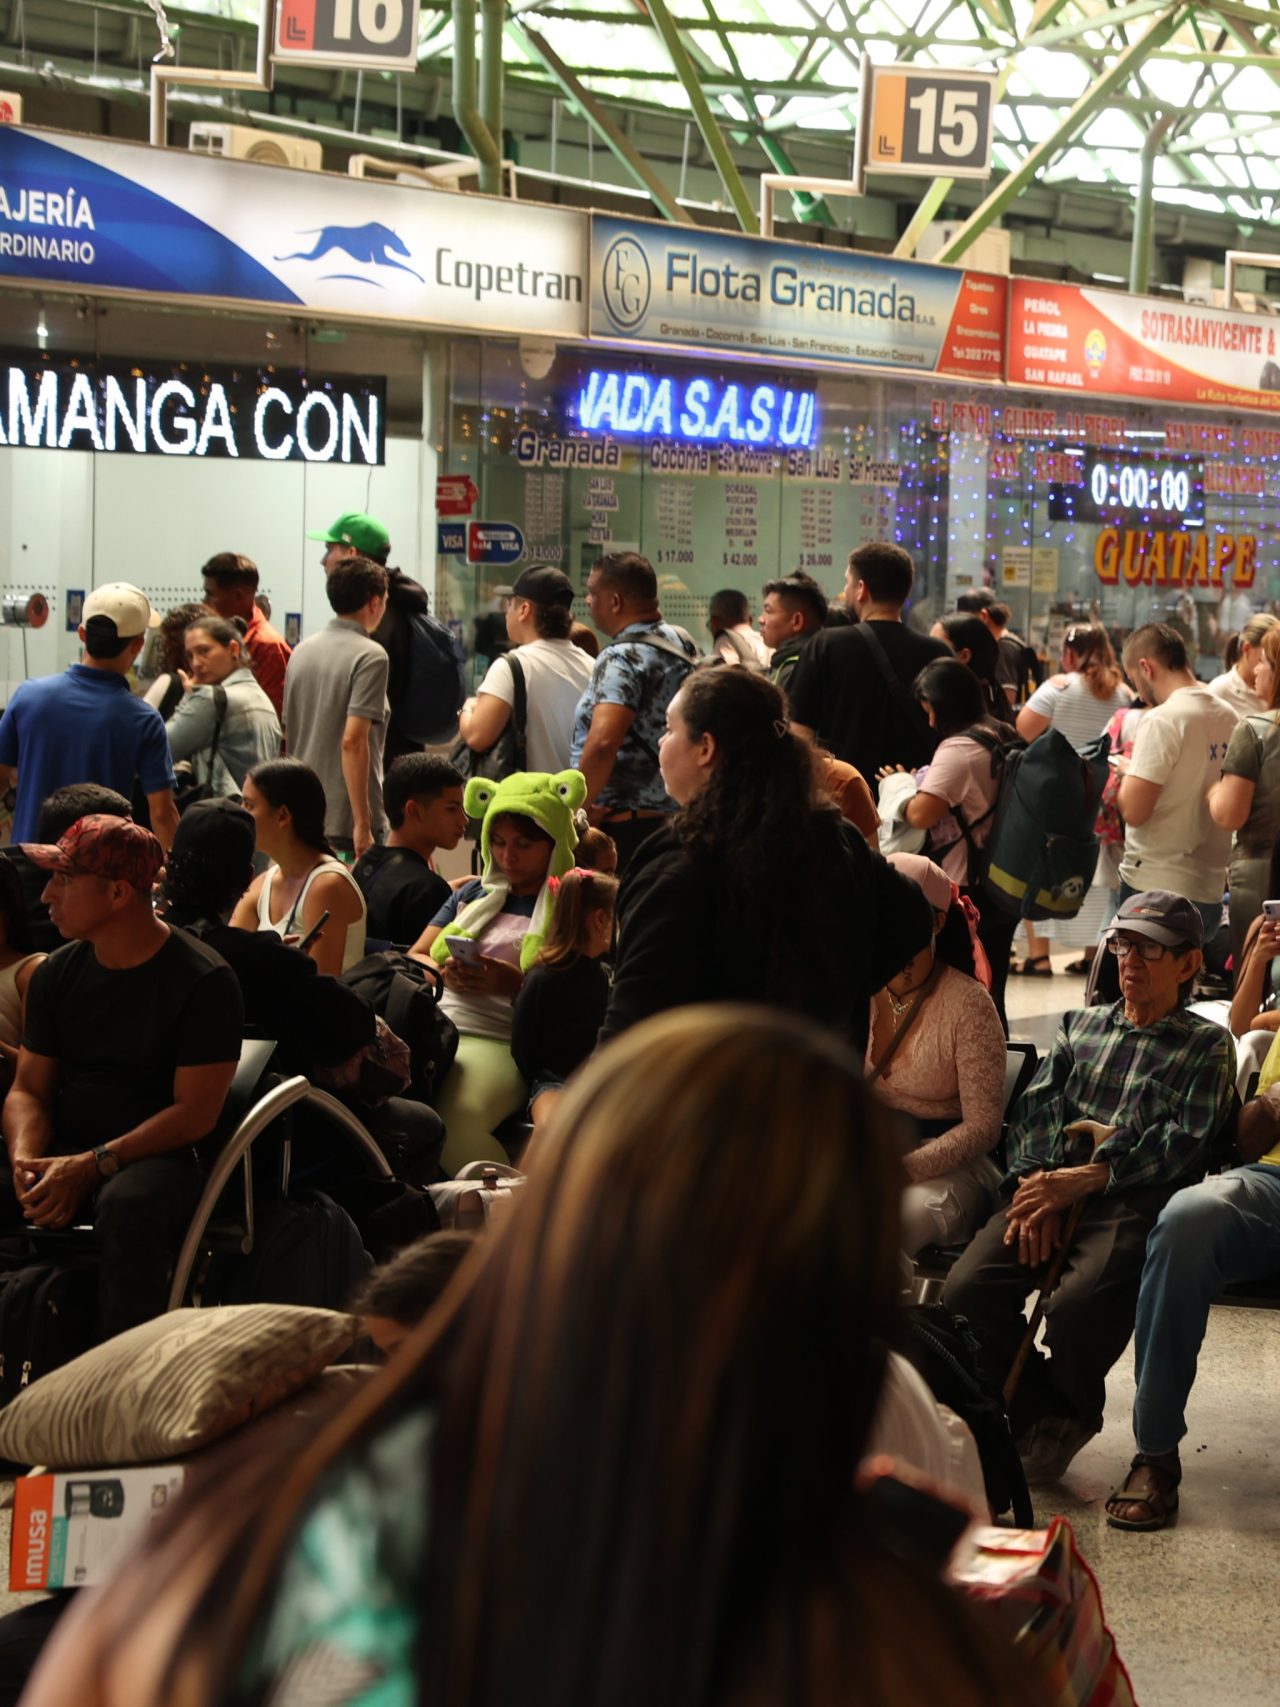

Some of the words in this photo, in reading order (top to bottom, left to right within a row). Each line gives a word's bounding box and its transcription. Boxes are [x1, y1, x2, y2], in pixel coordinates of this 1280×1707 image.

[910, 87, 978, 157] 15
[0, 187, 96, 231] AJERÍA
[436, 248, 582, 303] Copetran
[666, 252, 760, 301] Flota
[771, 266, 915, 322] Granada
[750, 333, 768, 345] San
[769, 334, 786, 347] Luis
[792, 337, 809, 350] San
[1141, 310, 1262, 355] SOTRASANVICENTE
[1267, 329, 1275, 355] &
[1024, 368, 1045, 382] SAN
[0, 367, 239, 458] MANGA
[254, 387, 377, 464] CON
[778, 389, 815, 446] U
[517, 430, 619, 468] Granada
[1092, 464, 1189, 511] 0:00:00
[442, 535, 464, 549] VISA
[501, 542, 520, 551] VISA
[1093, 528, 1257, 588] GUATAPE
